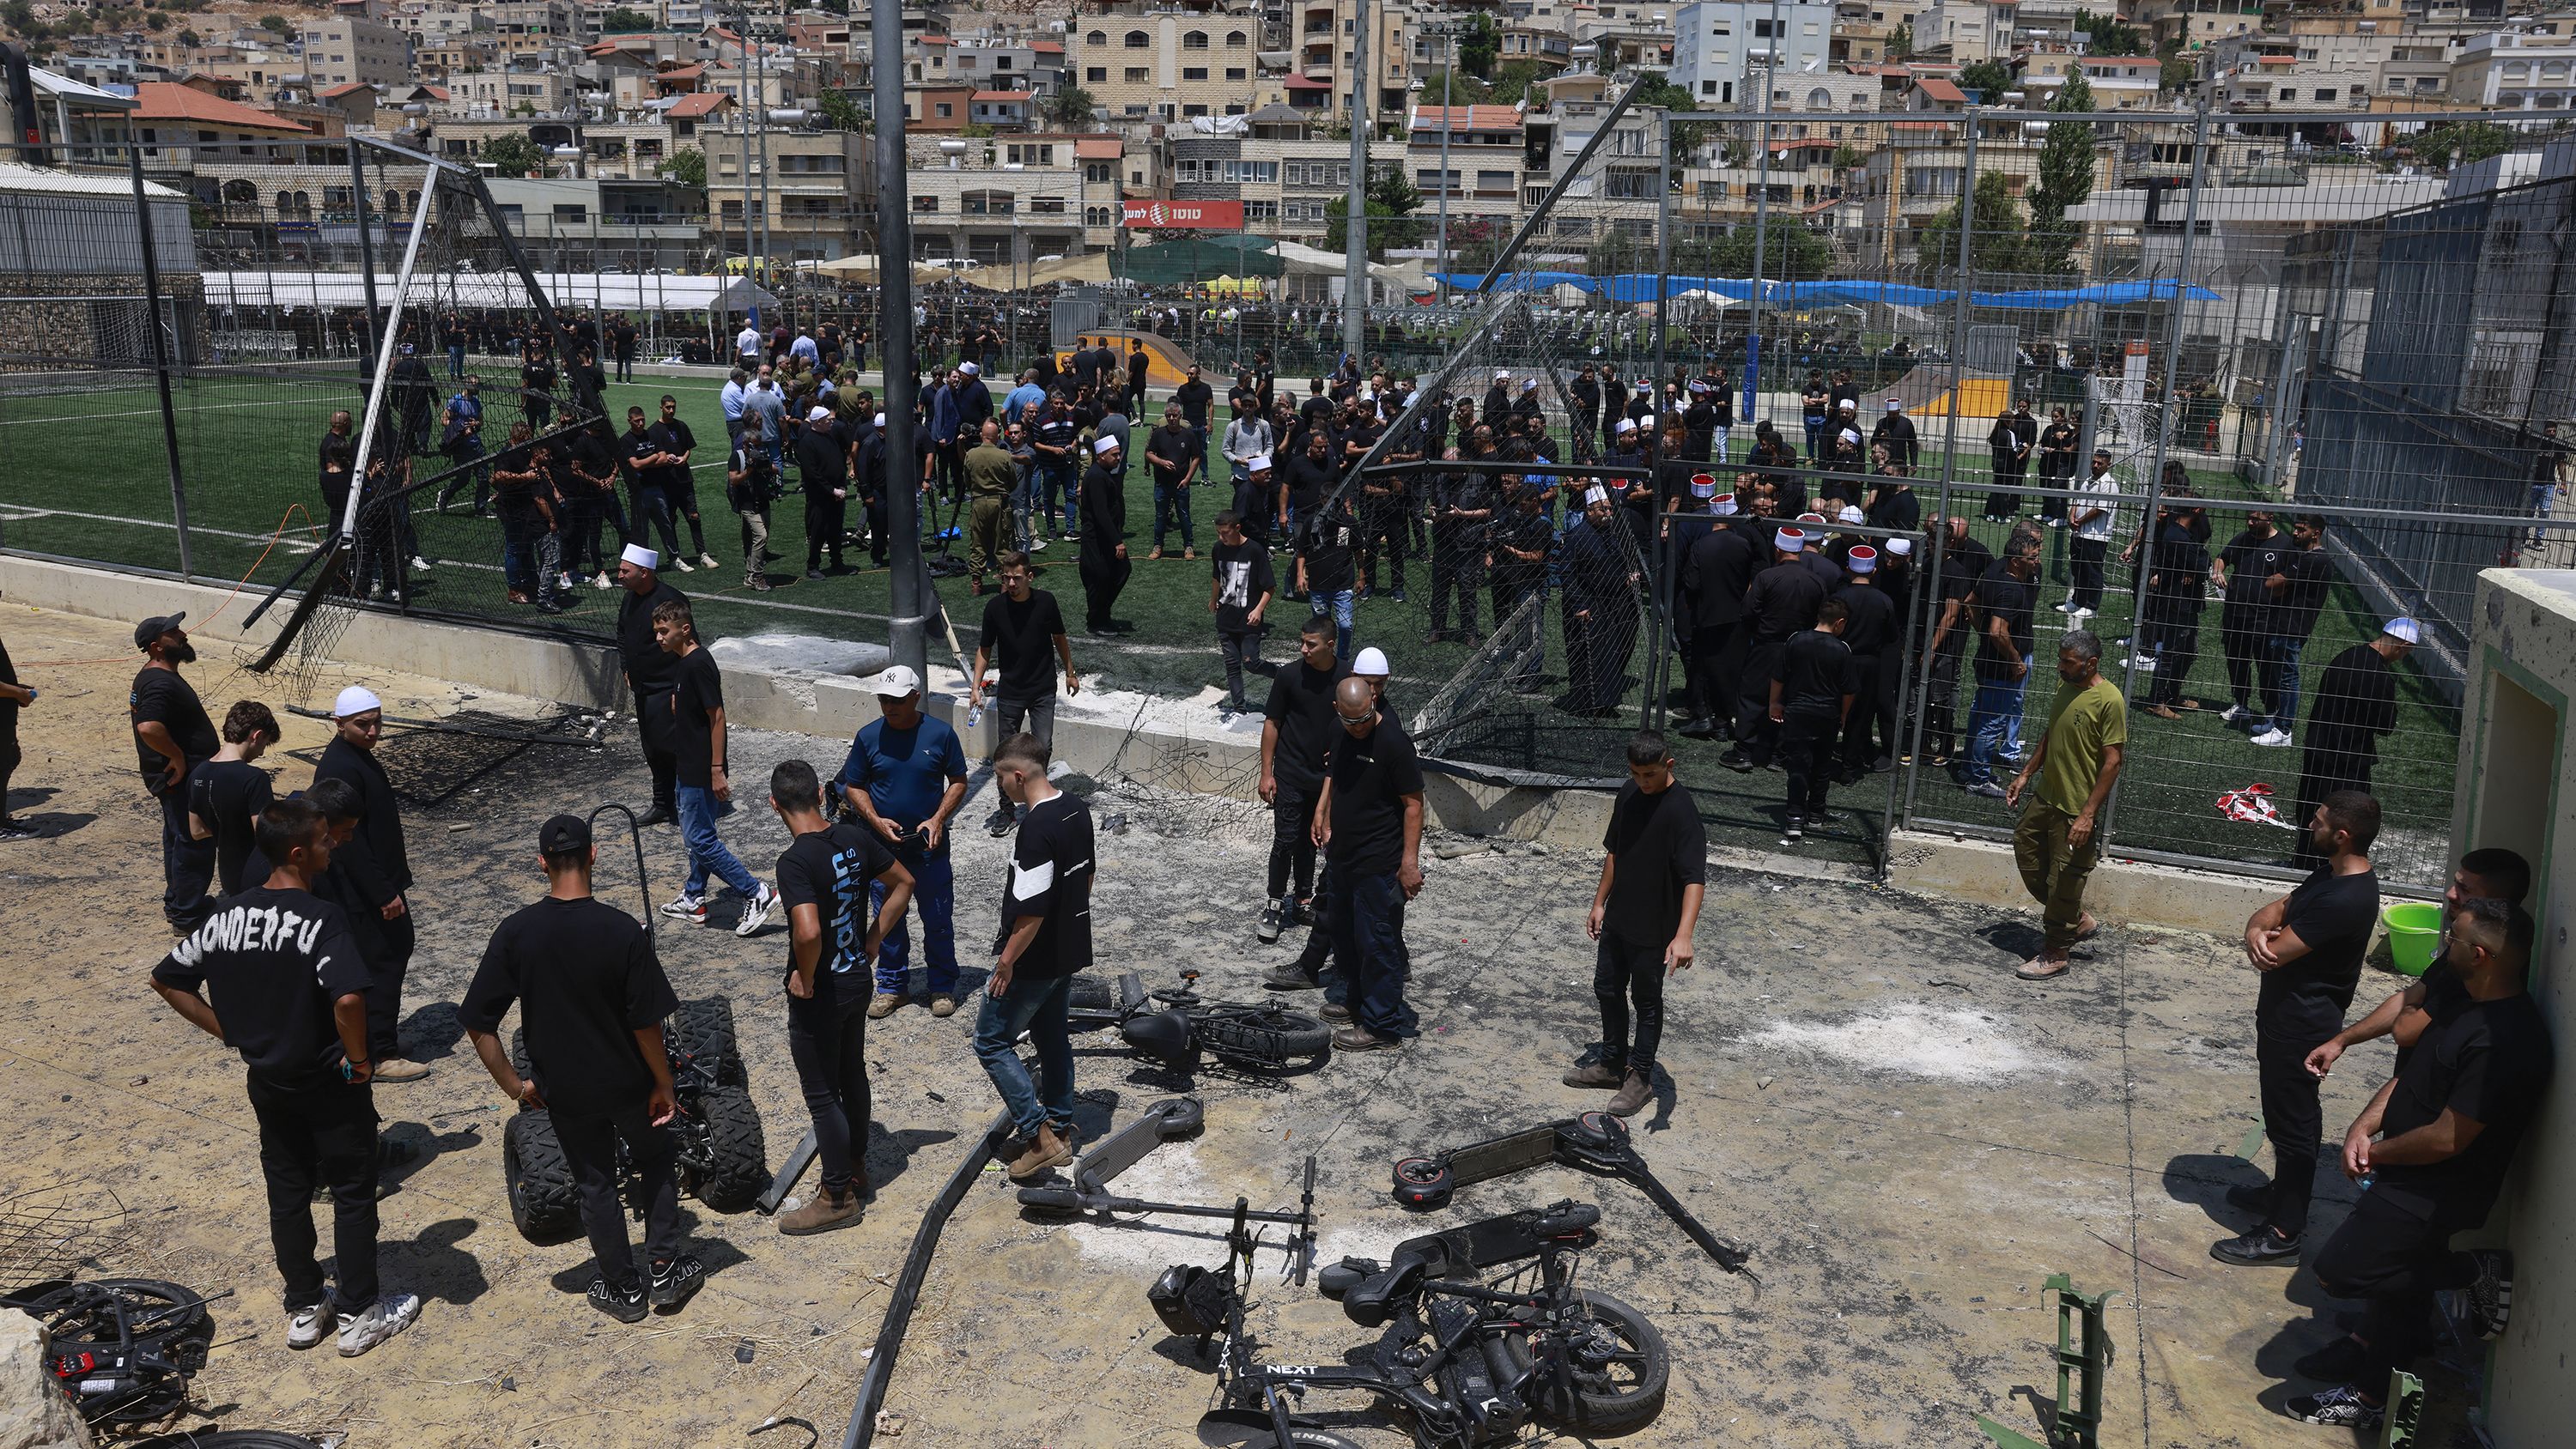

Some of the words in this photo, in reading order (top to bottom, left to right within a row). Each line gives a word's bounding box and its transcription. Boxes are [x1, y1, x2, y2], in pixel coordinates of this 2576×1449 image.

[1173, 209, 1201, 220] טוטו
[1267, 1365, 1319, 1374] NEXT
[1292, 1432, 1340, 1446] ENDA
